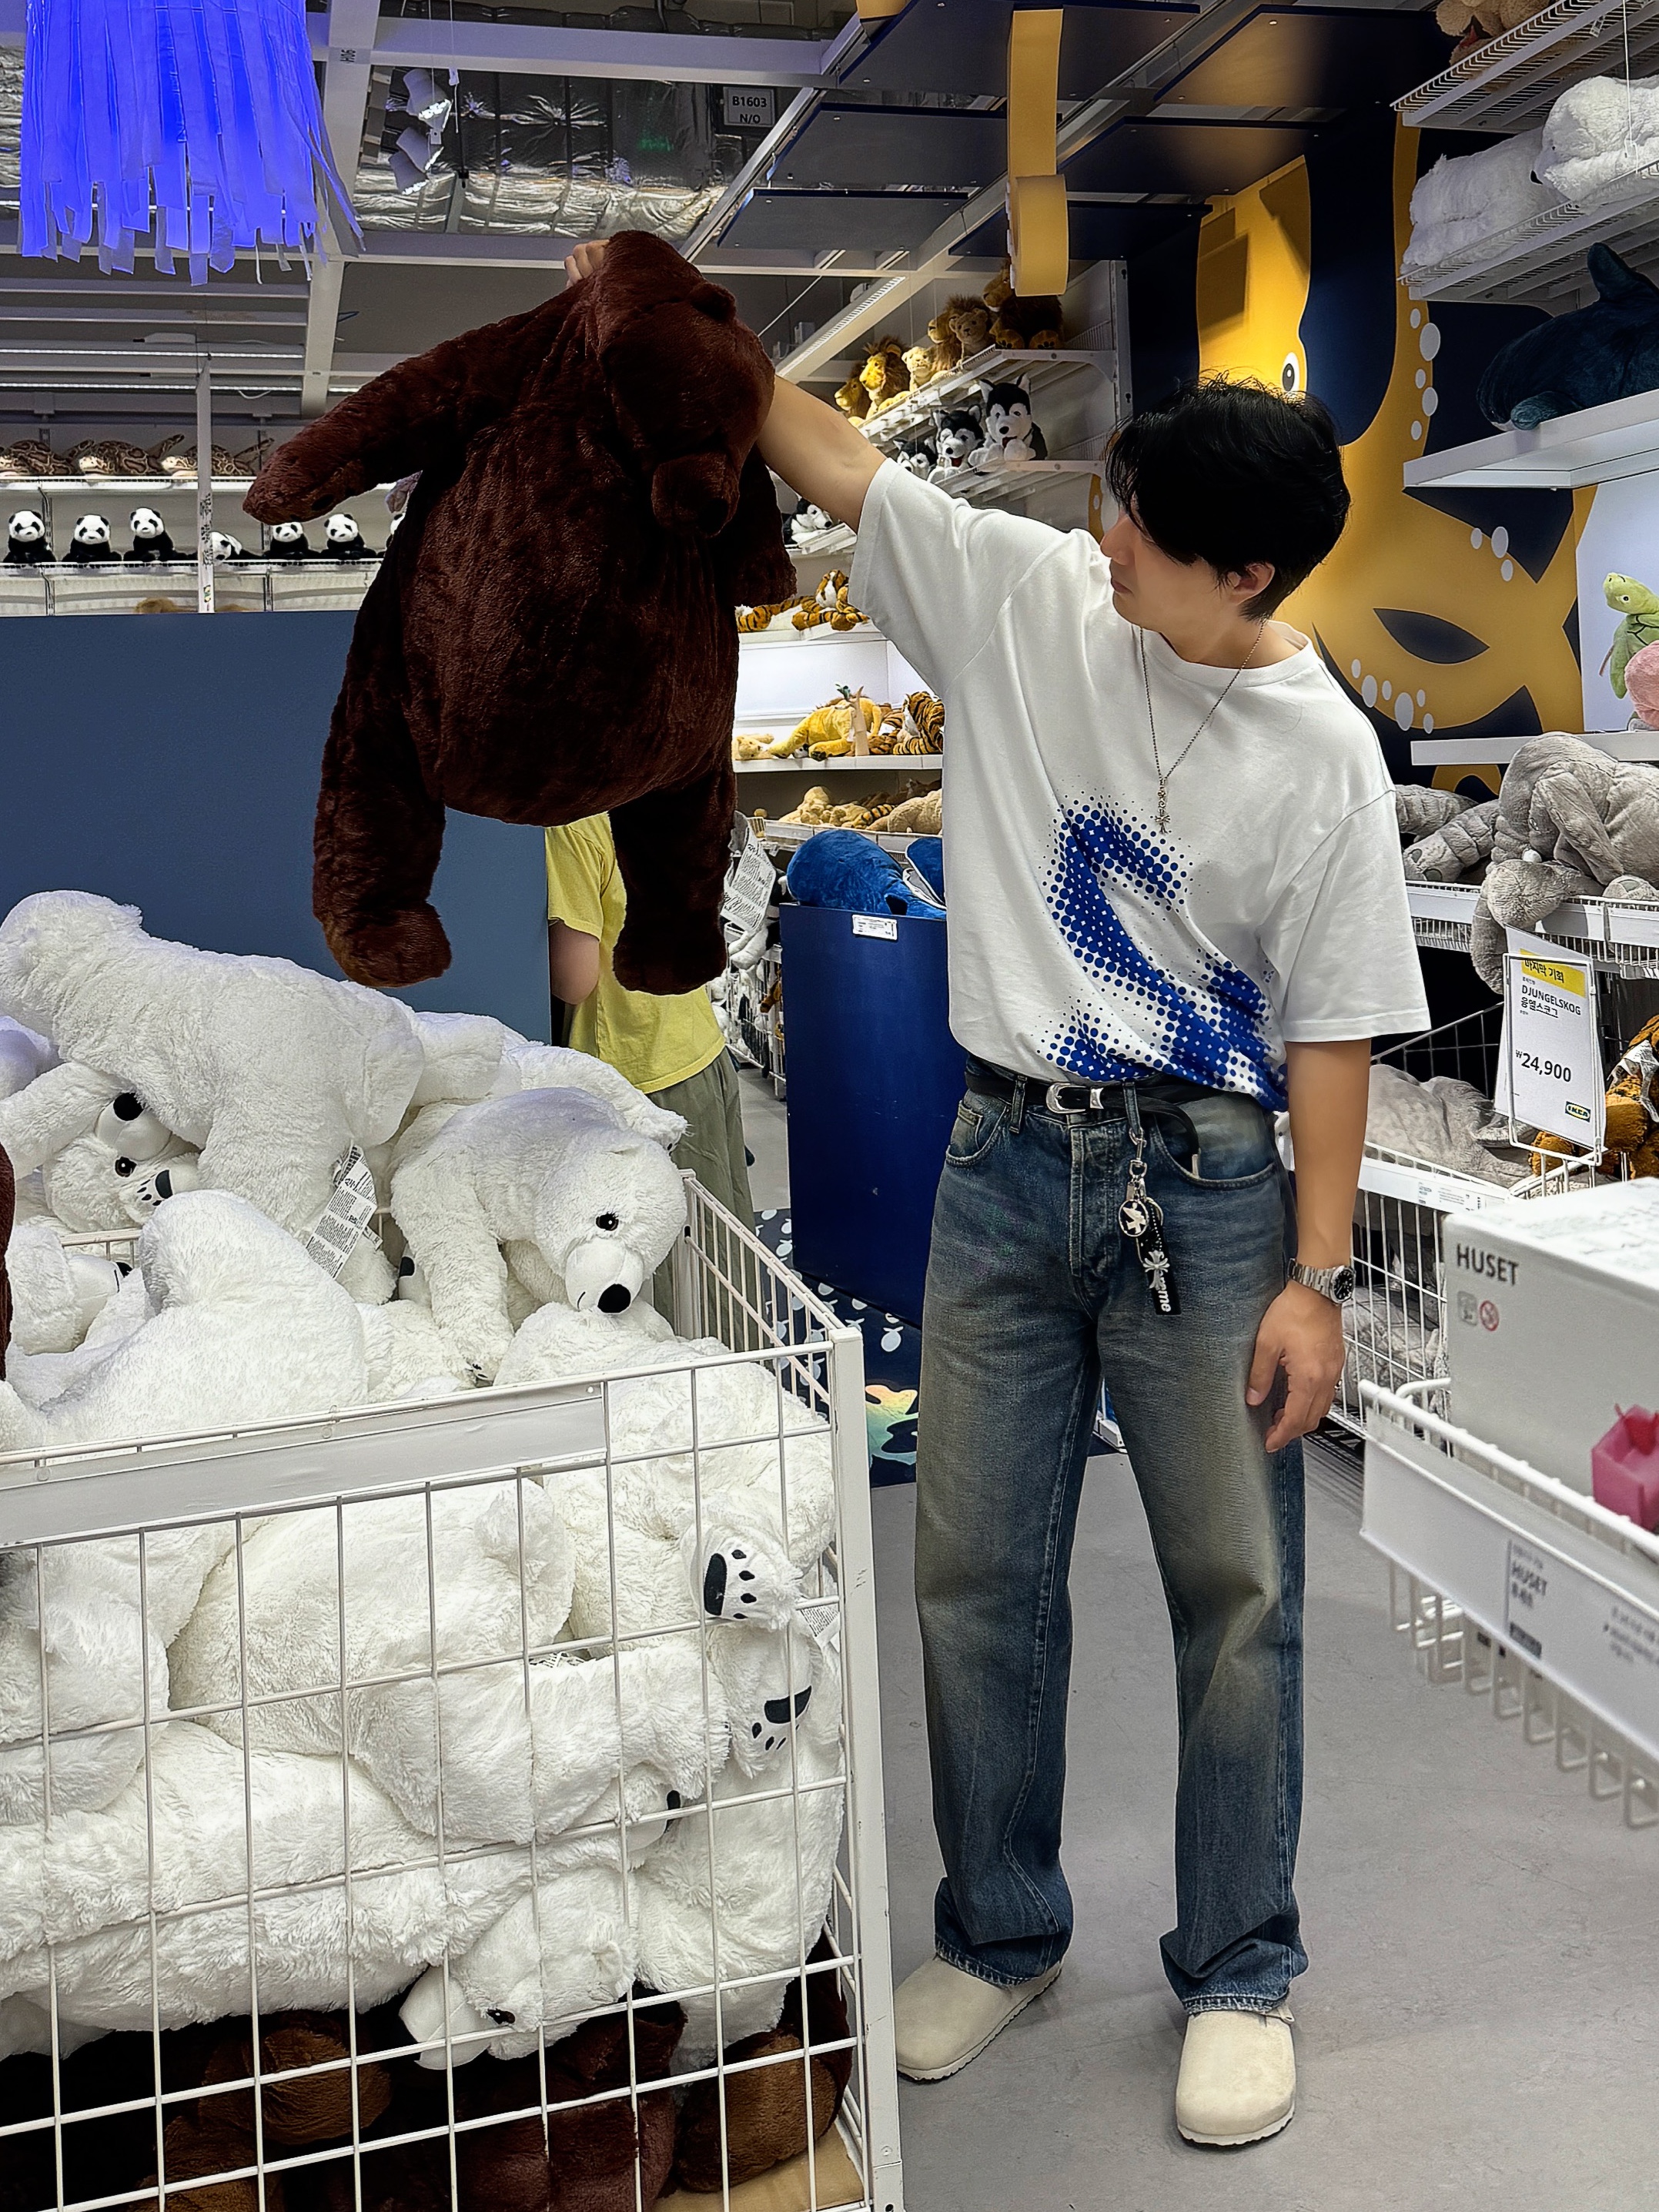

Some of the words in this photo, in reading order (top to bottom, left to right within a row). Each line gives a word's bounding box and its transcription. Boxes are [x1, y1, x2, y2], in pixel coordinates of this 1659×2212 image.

[732, 95, 767, 108] B1603
[740, 113, 761, 124] N/O
[1524, 959, 1547, 977] 마지막
[1548, 967, 1565, 984] 기회
[1521, 984, 1581, 1016] DJUNGELSKOG
[1515, 1049, 1571, 1082] ₩24,900
[1567, 1106, 1588, 1117] IKEA
[1456, 1243, 1519, 1286] HUSET
